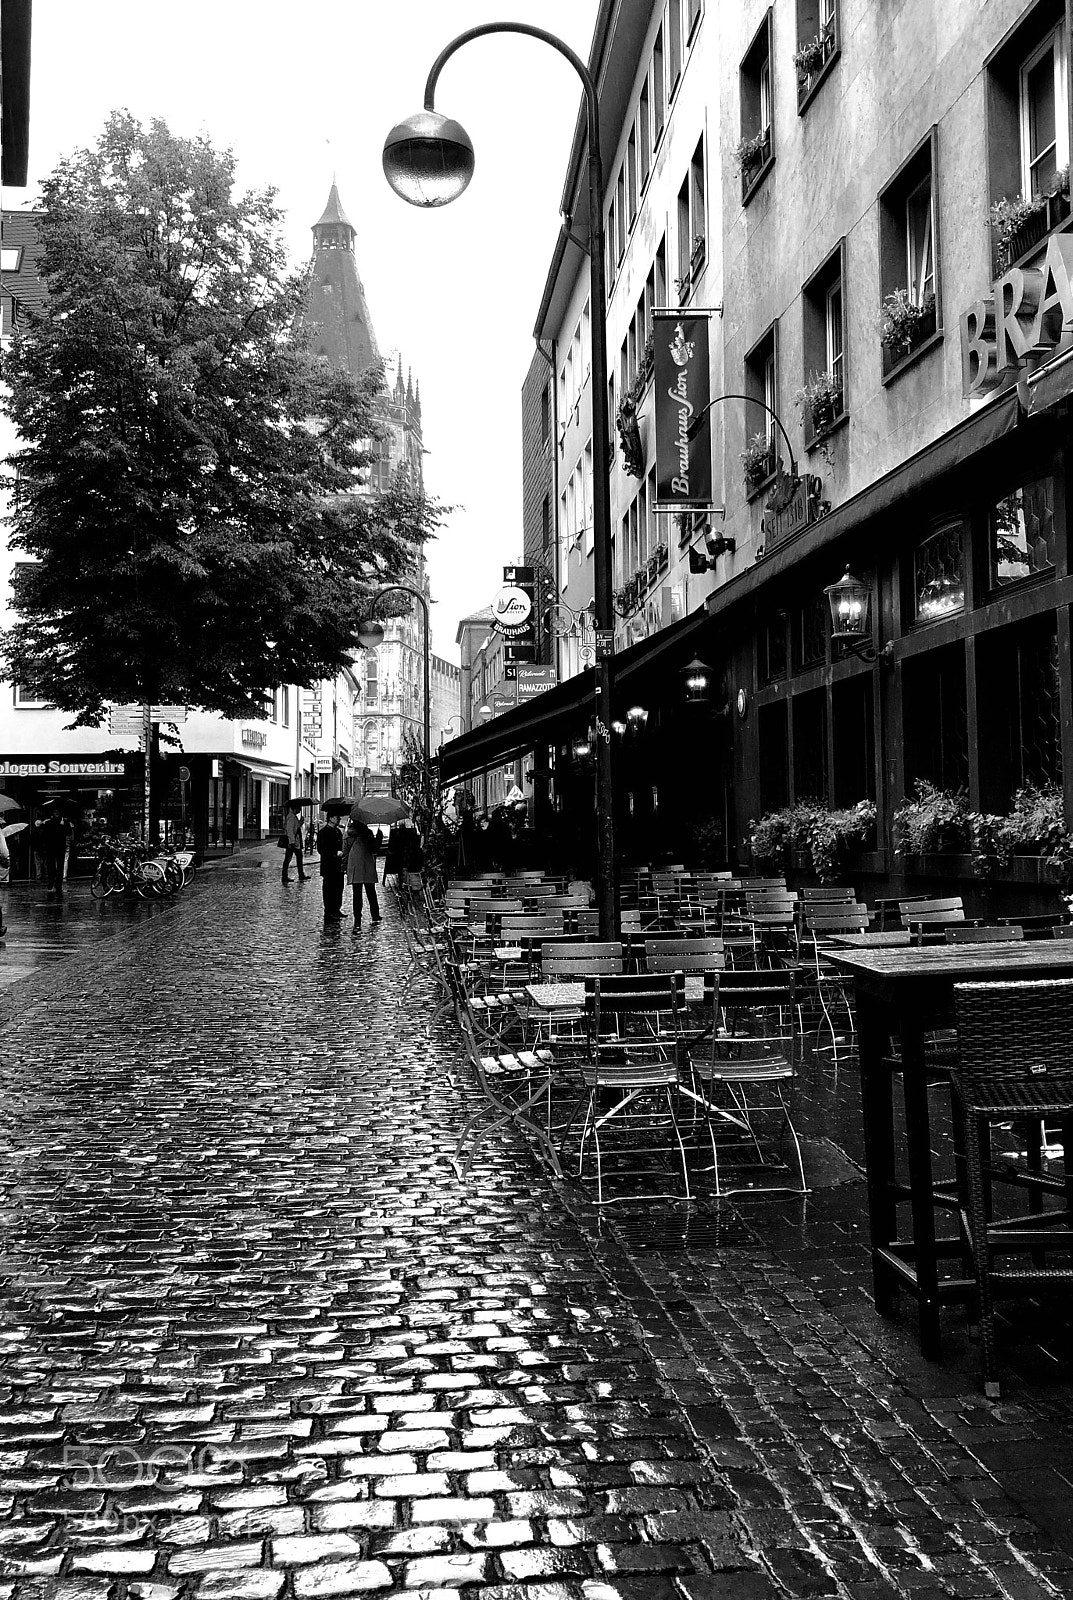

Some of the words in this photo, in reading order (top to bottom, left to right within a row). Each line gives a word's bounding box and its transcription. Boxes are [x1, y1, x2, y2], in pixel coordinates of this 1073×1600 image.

[667, 368, 694, 417] Sion
[671, 407, 690, 496] Brauhaus
[496, 597, 528, 614] Sion
[493, 623, 531, 636] BRAUHAUS
[48, 760, 125, 773] Souvenirs
